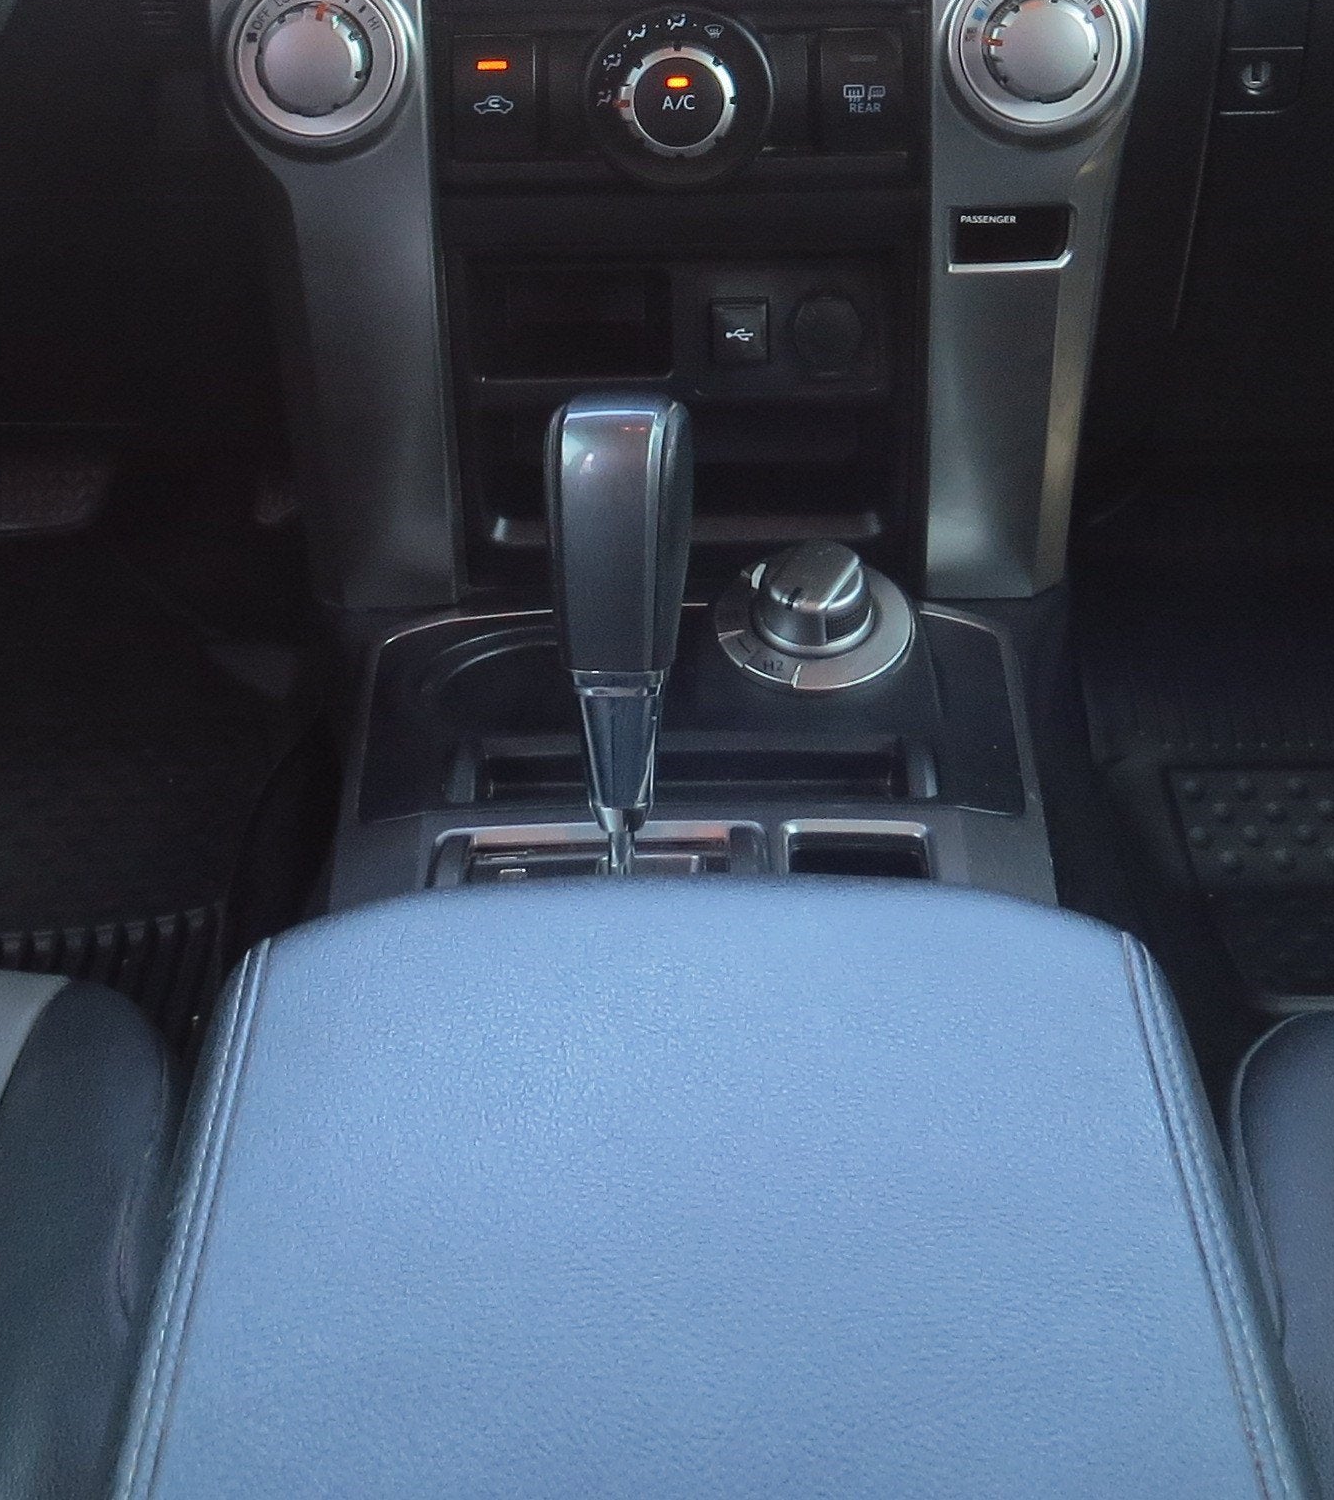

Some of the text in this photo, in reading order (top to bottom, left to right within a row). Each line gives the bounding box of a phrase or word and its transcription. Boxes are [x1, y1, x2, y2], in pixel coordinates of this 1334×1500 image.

[253, 9, 271, 30] OFF
[368, 16, 380, 31] HI
[662, 94, 696, 111] A/C
[849, 103, 882, 113] REAR
[960, 215, 1017, 224] PASSENGER
